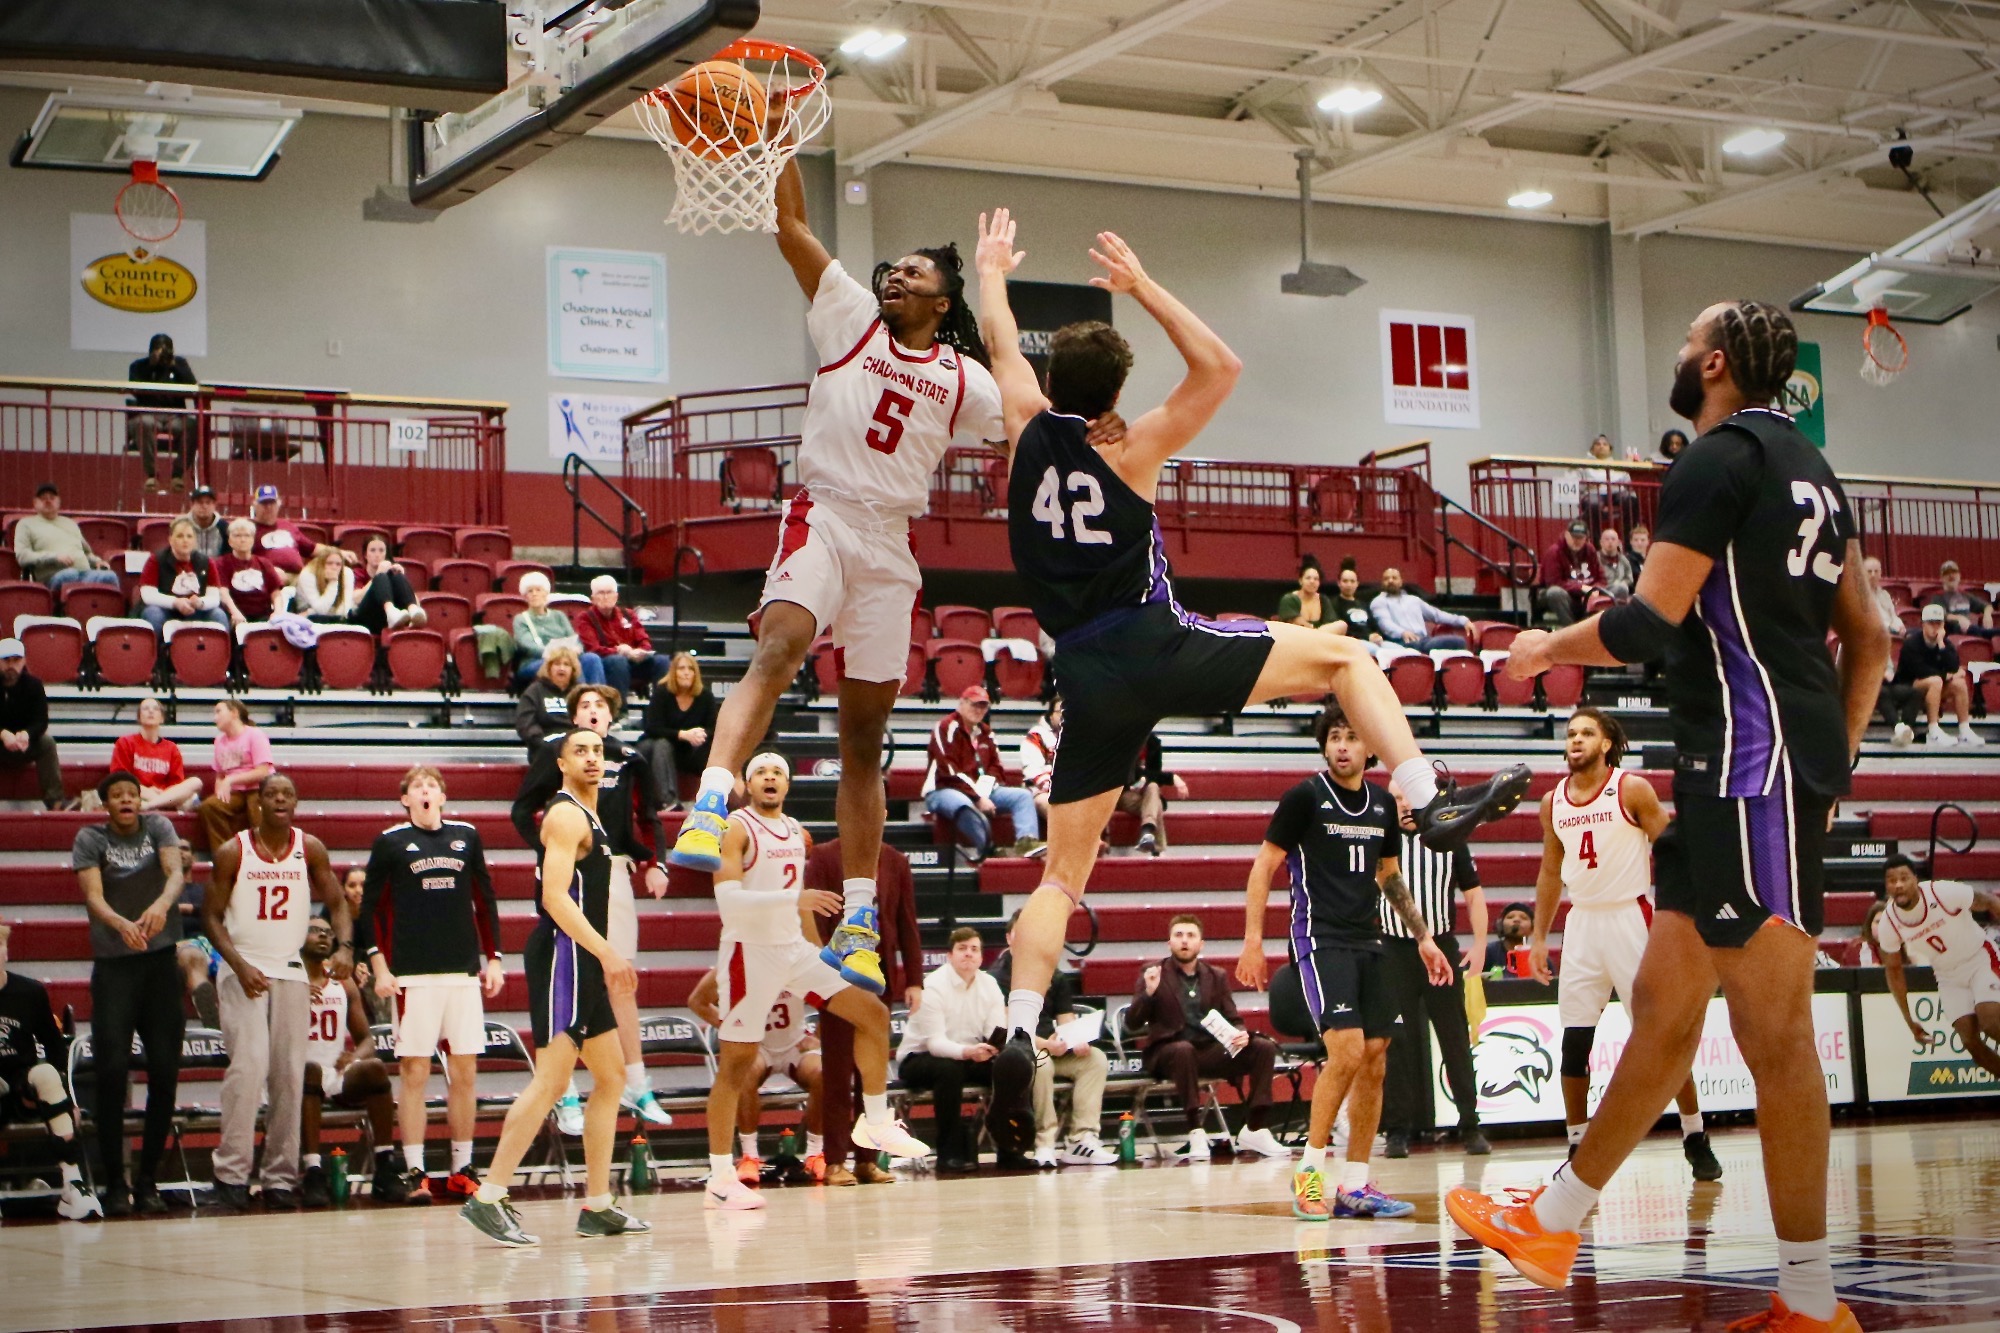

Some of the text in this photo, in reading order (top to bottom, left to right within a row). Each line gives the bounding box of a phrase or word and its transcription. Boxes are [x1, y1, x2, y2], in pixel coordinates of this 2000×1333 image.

[99, 264, 179, 284] Country
[103, 281, 176, 299] Kitchen
[562, 302, 652, 318] Chadron Medical
[624, 347, 638, 356] NE
[862, 356, 949, 405] CHADRON STATE
[1393, 399, 1470, 413] FOUNDATION
[865, 388, 915, 455] 5
[397, 426, 423, 440] 102
[1558, 483, 1576, 495] 104
[1031, 465, 1113, 545] 42
[1617, 697, 1651, 708] GO EAGLES!
[1558, 811, 1613, 829] CHADRON STATE
[1348, 845, 1365, 872] 11
[1578, 830, 1598, 869] 4
[1851, 843, 1887, 856] GO EAGLES!
[409, 856, 465, 875] CHADRON
[246, 871, 301, 880] CHADRON STATE
[783, 863, 797, 890] 2
[256, 885, 290, 920] 12
[1925, 935, 1947, 954] 0
[308, 1009, 337, 1041] 20
[764, 1003, 791, 1031] 3
[640, 1024, 693, 1041] EAGLES
